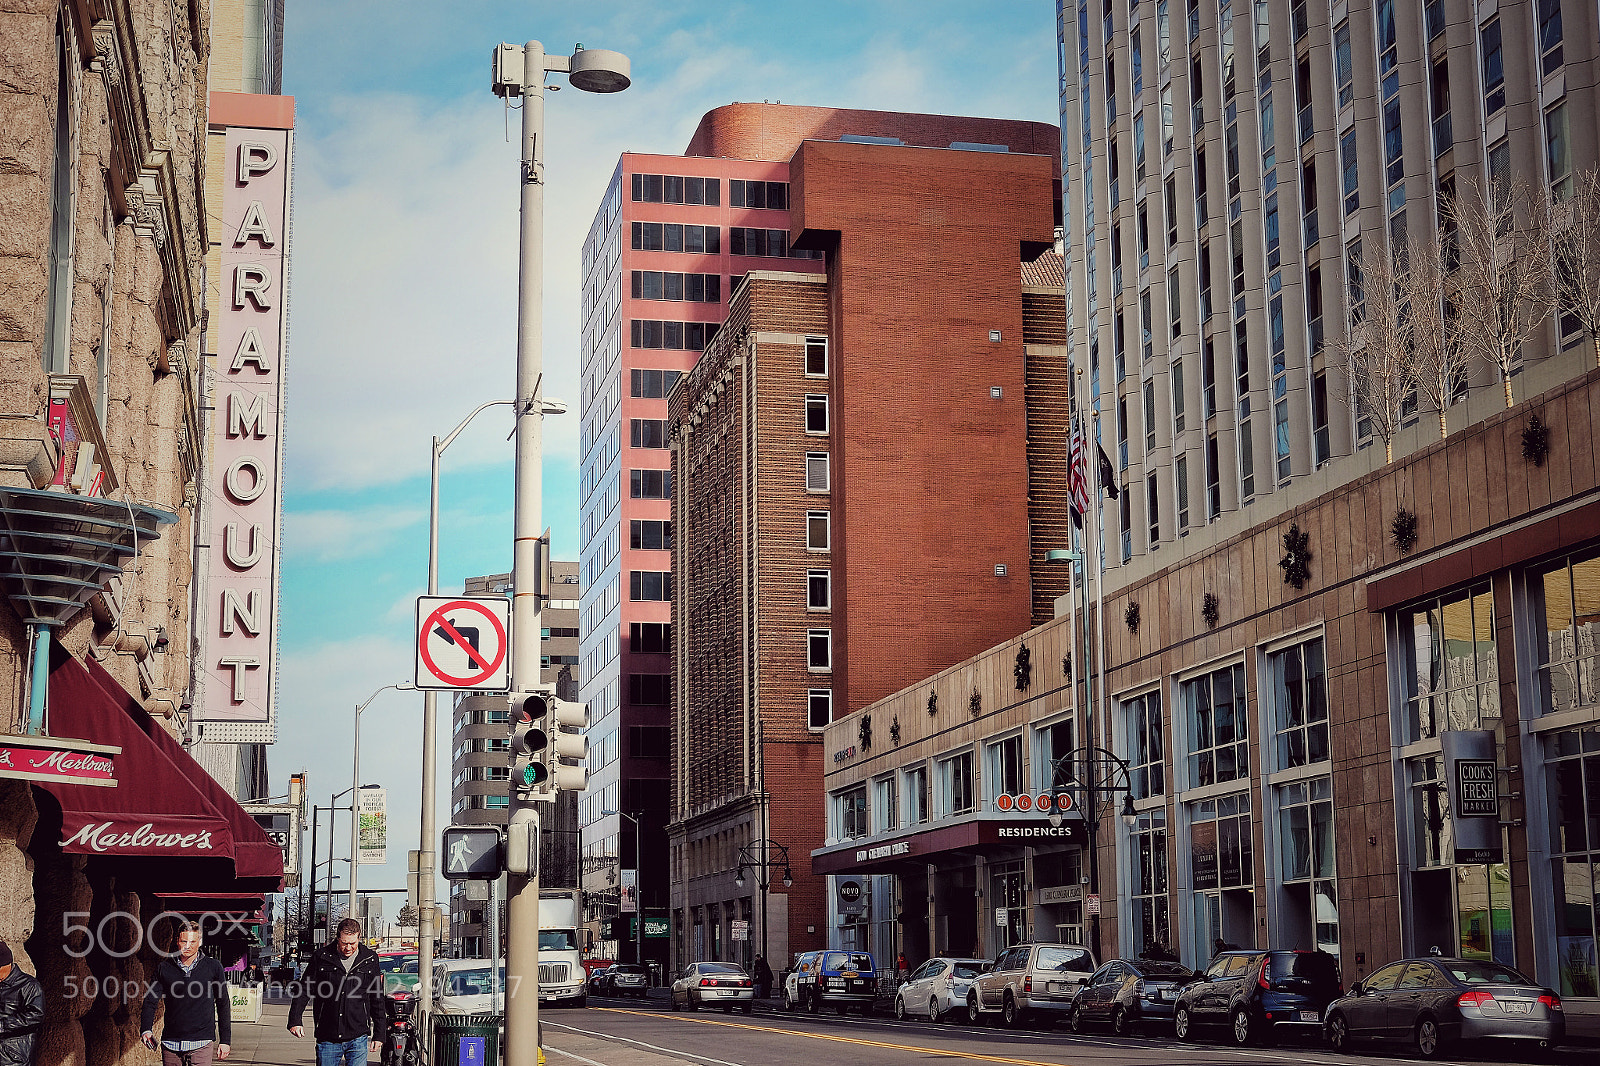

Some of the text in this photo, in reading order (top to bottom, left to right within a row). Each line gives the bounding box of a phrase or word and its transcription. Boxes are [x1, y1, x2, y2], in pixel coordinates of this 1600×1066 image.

[219, 139, 279, 705] PARAMOUNT
[1462, 765, 1493, 780] COOK'S
[1463, 783, 1495, 799] FRESH
[999, 795, 1071, 811] 1600
[1463, 801, 1495, 811] MARKET
[58, 820, 213, 852] Marlowe's
[998, 826, 1072, 837] RESIDENCES
[841, 887, 859, 895] NOVO
[232, 995, 249, 1006] Bob's
